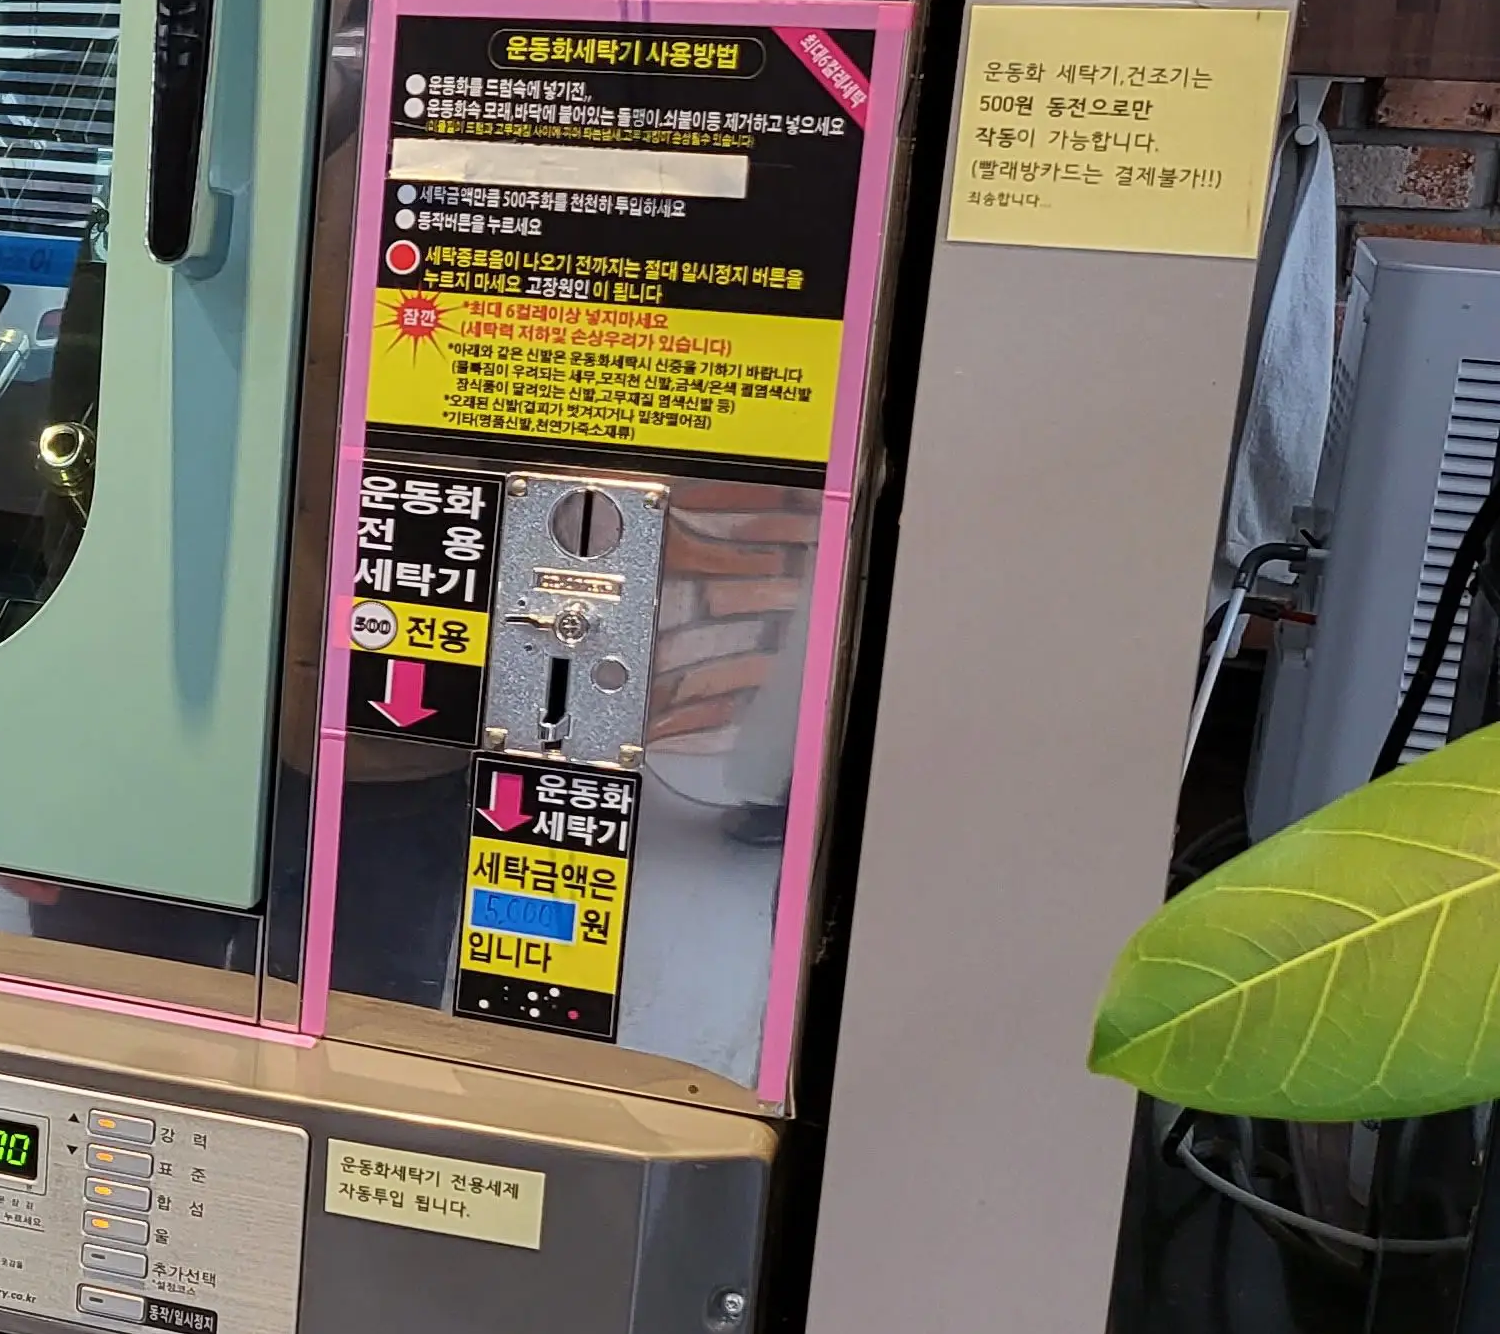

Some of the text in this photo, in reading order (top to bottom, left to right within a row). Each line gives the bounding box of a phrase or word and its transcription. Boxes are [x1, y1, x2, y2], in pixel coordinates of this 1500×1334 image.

[505, 35, 739, 69] 운동화세탁기 사용방법
[983, 62, 1213, 89] 운동화 세탁기,건조기는
[426, 99, 482, 118] 운동화속
[558, 105, 615, 127] 붙어있는
[724, 113, 782, 134] 제거하고
[786, 116, 845, 136] 넣으세요
[980, 95, 1153, 121] 500원 동전으로만
[975, 127, 1159, 153] 작동이 가능합니다.
[971, 159, 1222, 190] (빨래방카드는 결제불가!!)
[420, 186, 500, 208] 세탁금액만큼
[502, 190, 568, 211] 500주화를
[615, 196, 687, 218] 투입하세요
[418, 211, 542, 236] 동작버튼을 누르세요
[425, 246, 803, 290] 세탁종료음이 나오기 전까지는 절대 일시정지 버튼을
[424, 270, 470, 292] 누르지
[474, 274, 521, 294] 마세요
[525, 276, 590, 300] 고장원인
[613, 282, 663, 304] 됩니다
[403, 308, 437, 327] 잠깐
[359, 474, 486, 522] 운동화
[353, 556, 476, 605] 세탁기
[353, 615, 470, 655] 500 전용
[535, 774, 632, 816] 운동화
[533, 812, 628, 853] 세탁기
[472, 850, 617, 904] 세탁금액은
[580, 908, 610, 945] 원
[468, 931, 552, 974] 입니다
[340, 1156, 519, 1200] 운동화세탁기 전용세제
[338, 1183, 470, 1218] 자동투입 됩니다.
[152, 1262, 216, 1288] 추가선택
[149, 1305, 213, 1332] 동작/일시정지
